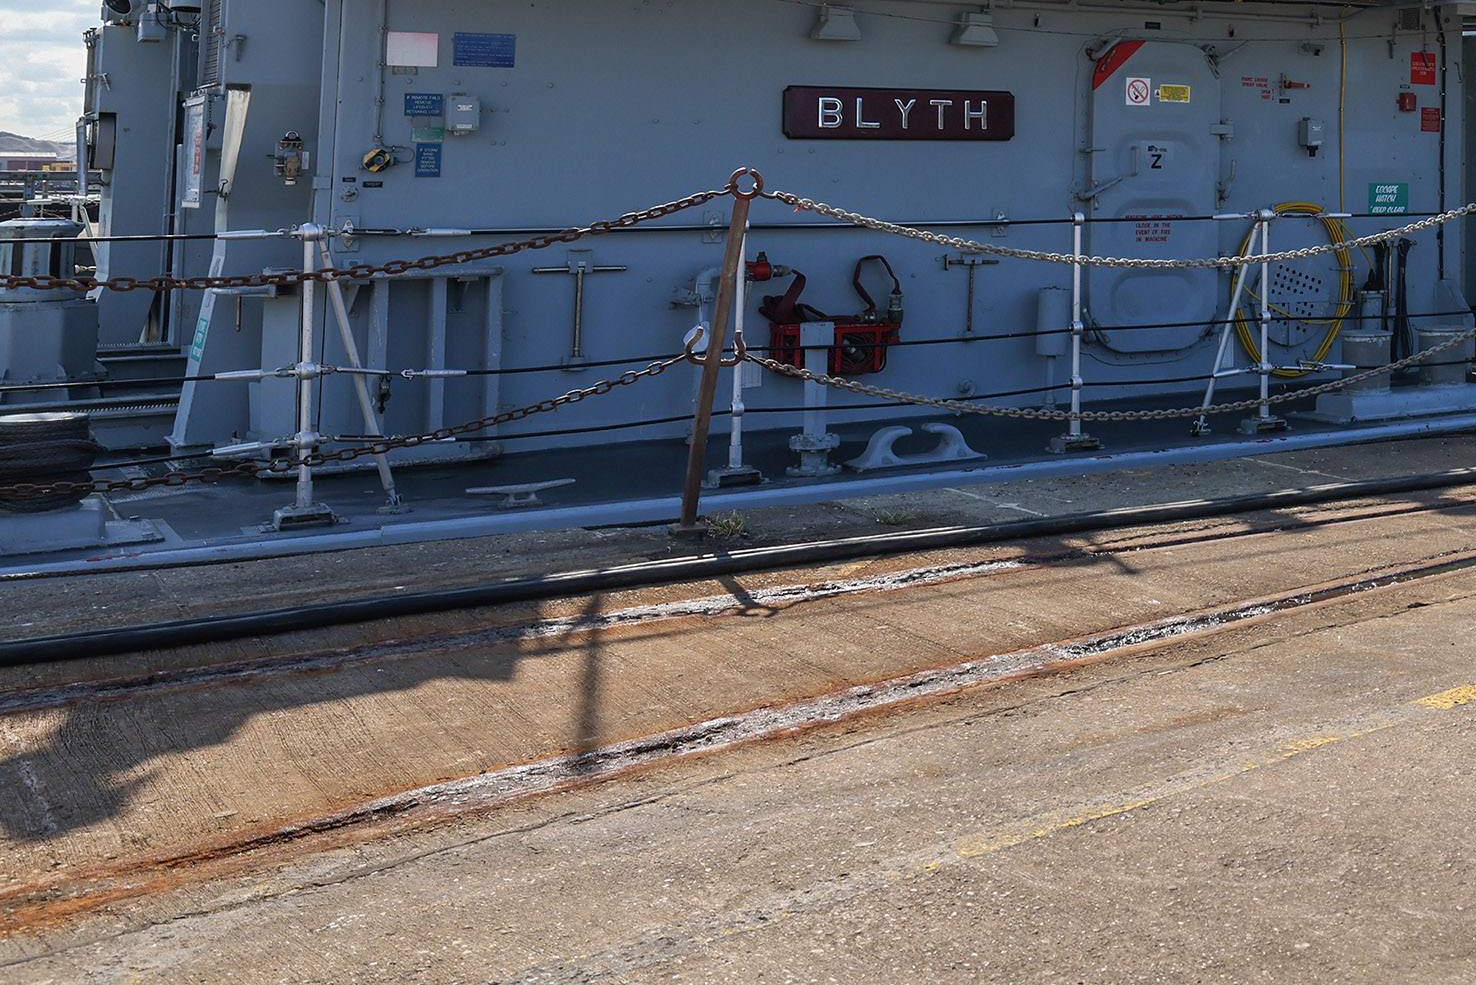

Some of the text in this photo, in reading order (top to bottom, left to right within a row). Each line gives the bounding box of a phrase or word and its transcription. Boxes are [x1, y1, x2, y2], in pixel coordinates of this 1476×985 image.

[818, 97, 988, 130] BLYTH
[1151, 154, 1162, 169] Z
[1375, 185, 1399, 194] ESCAPE
[1375, 194, 1397, 203] HATCH
